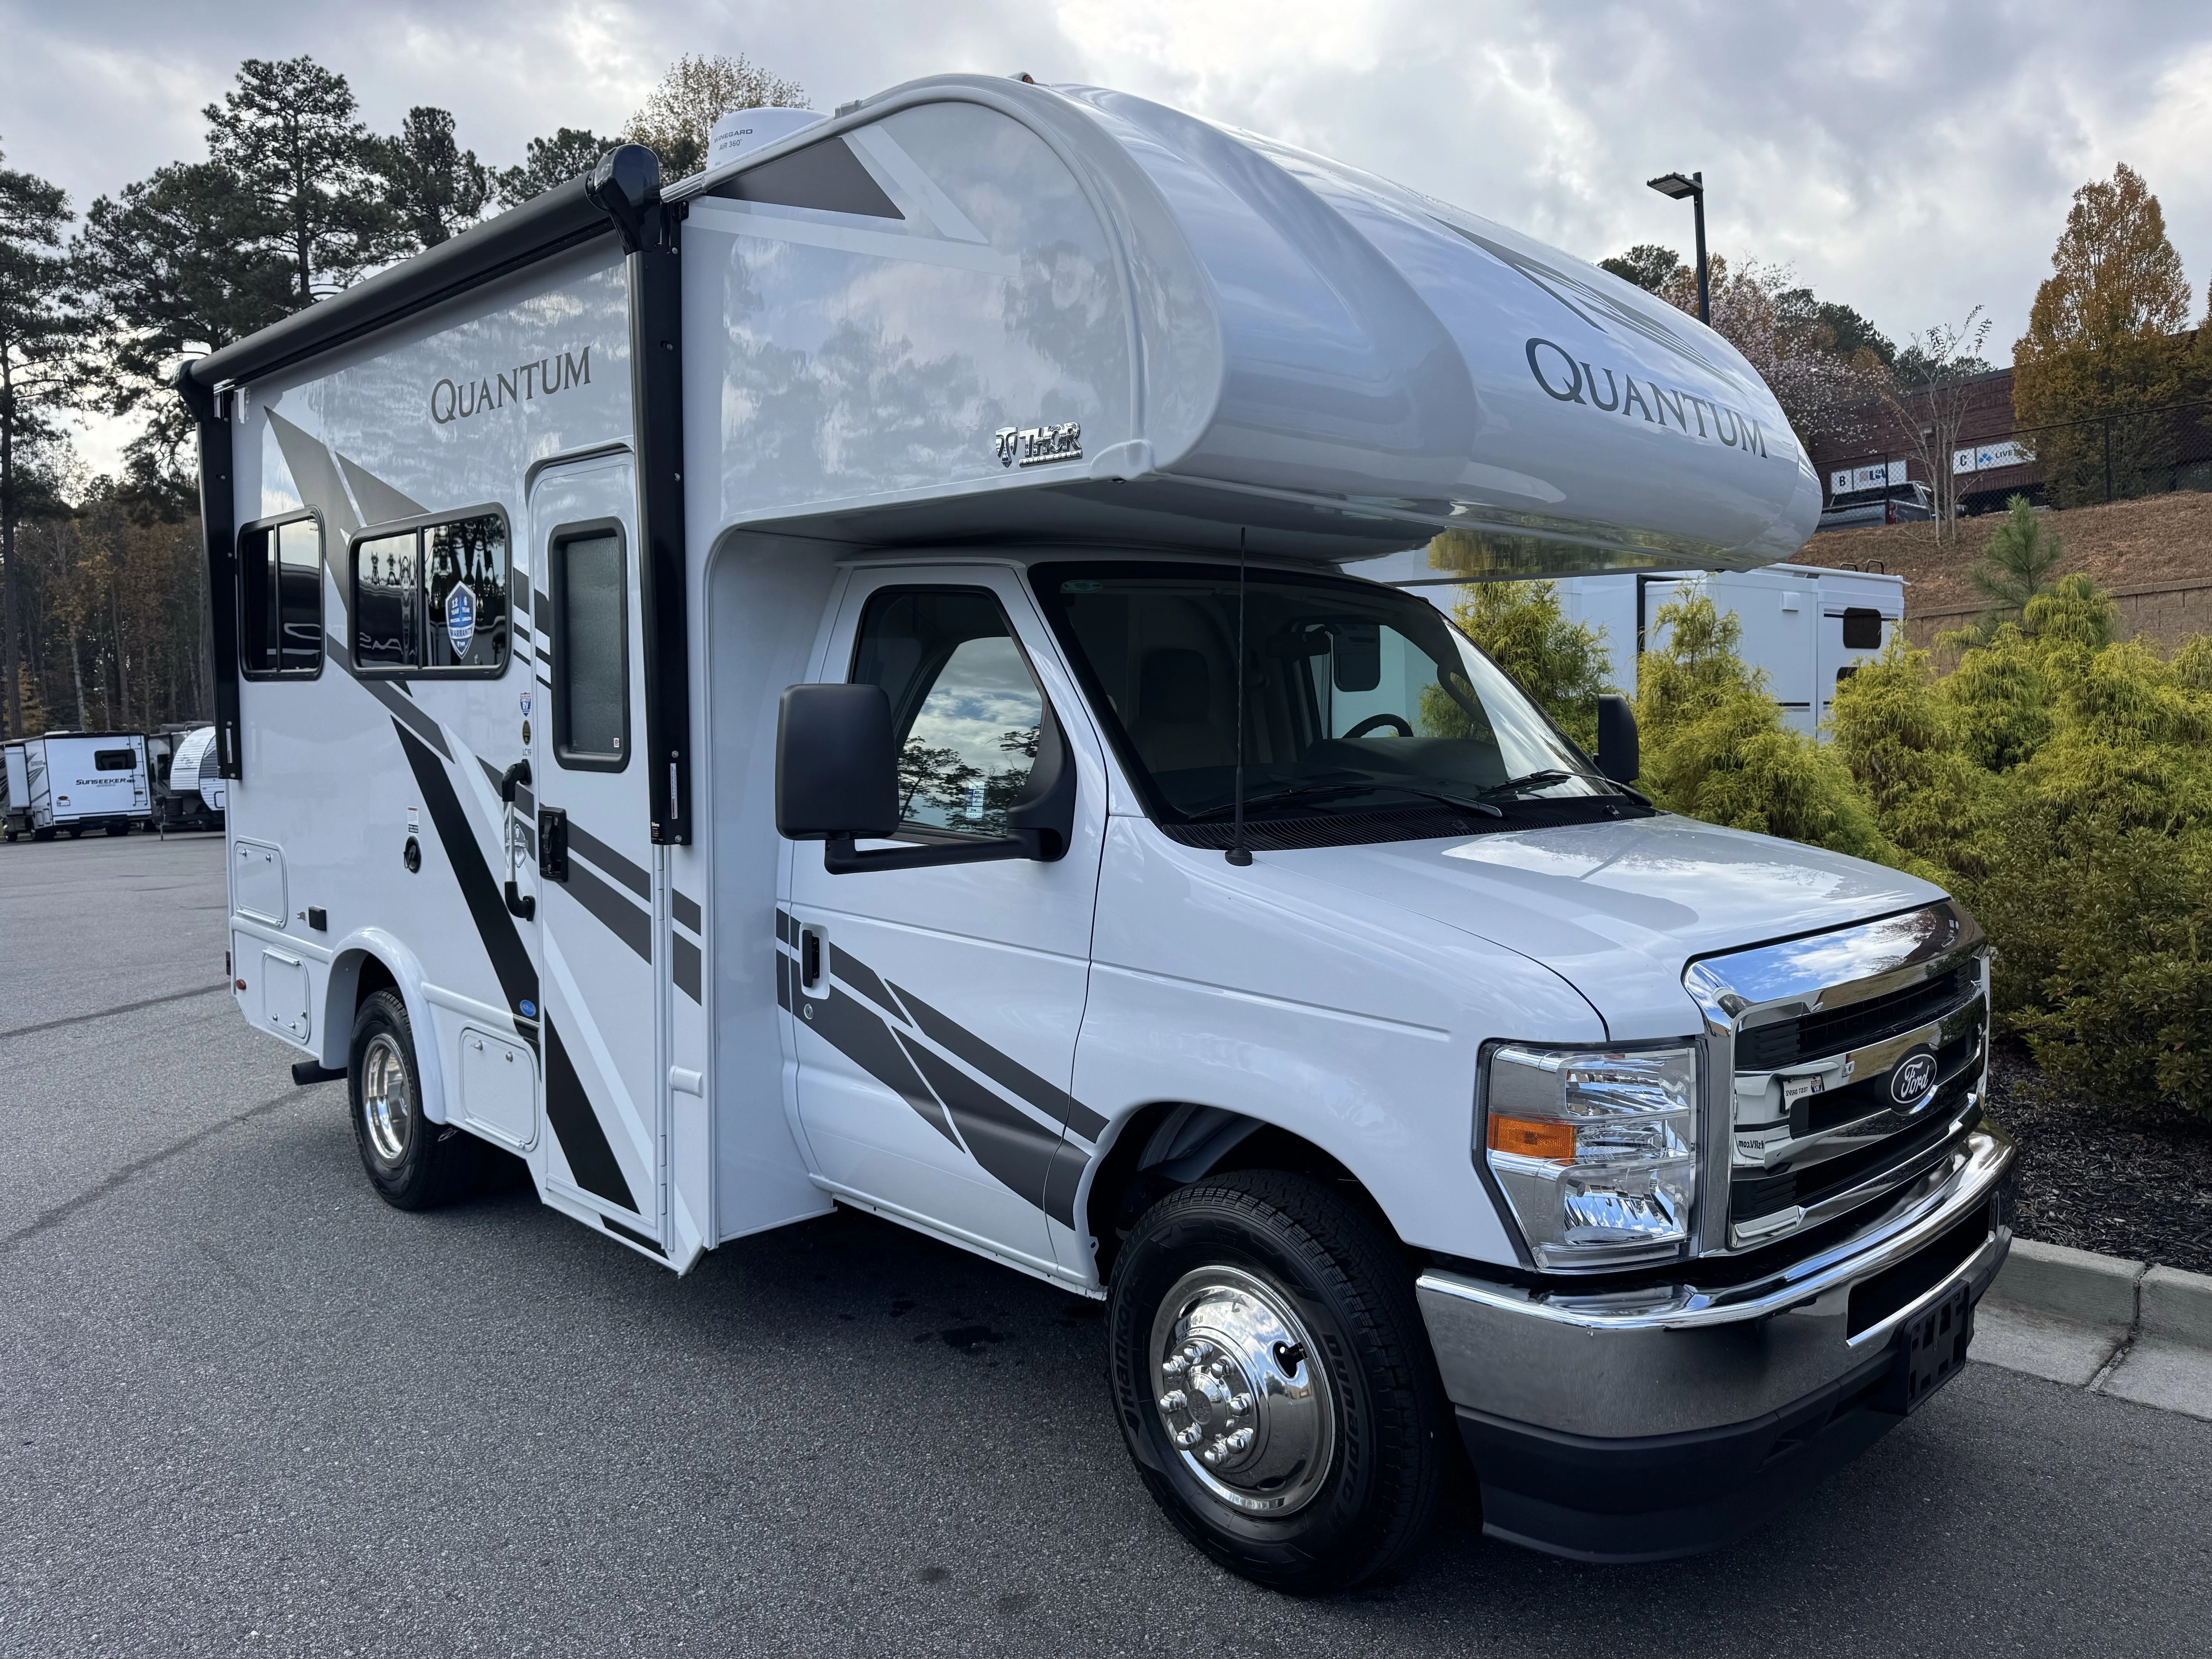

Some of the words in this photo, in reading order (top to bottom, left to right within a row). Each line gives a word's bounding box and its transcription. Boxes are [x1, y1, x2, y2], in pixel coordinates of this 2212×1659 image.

[714, 129, 753, 143] WINEGARD
[719, 143, 728, 151] AIR
[431, 345, 591, 424] QUANTUM
[1525, 338, 1768, 459] QUANTUM
[1019, 422, 1082, 457] THOR
[1020, 456, 1047, 464] MOTOR
[1960, 455, 1967, 467] C
[1839, 476, 1846, 486] B
[452, 597, 458, 608] 12
[464, 596, 467, 606] 6
[450, 627, 472, 637] WARRANTY
[1901, 1061, 1929, 1097] Ford
